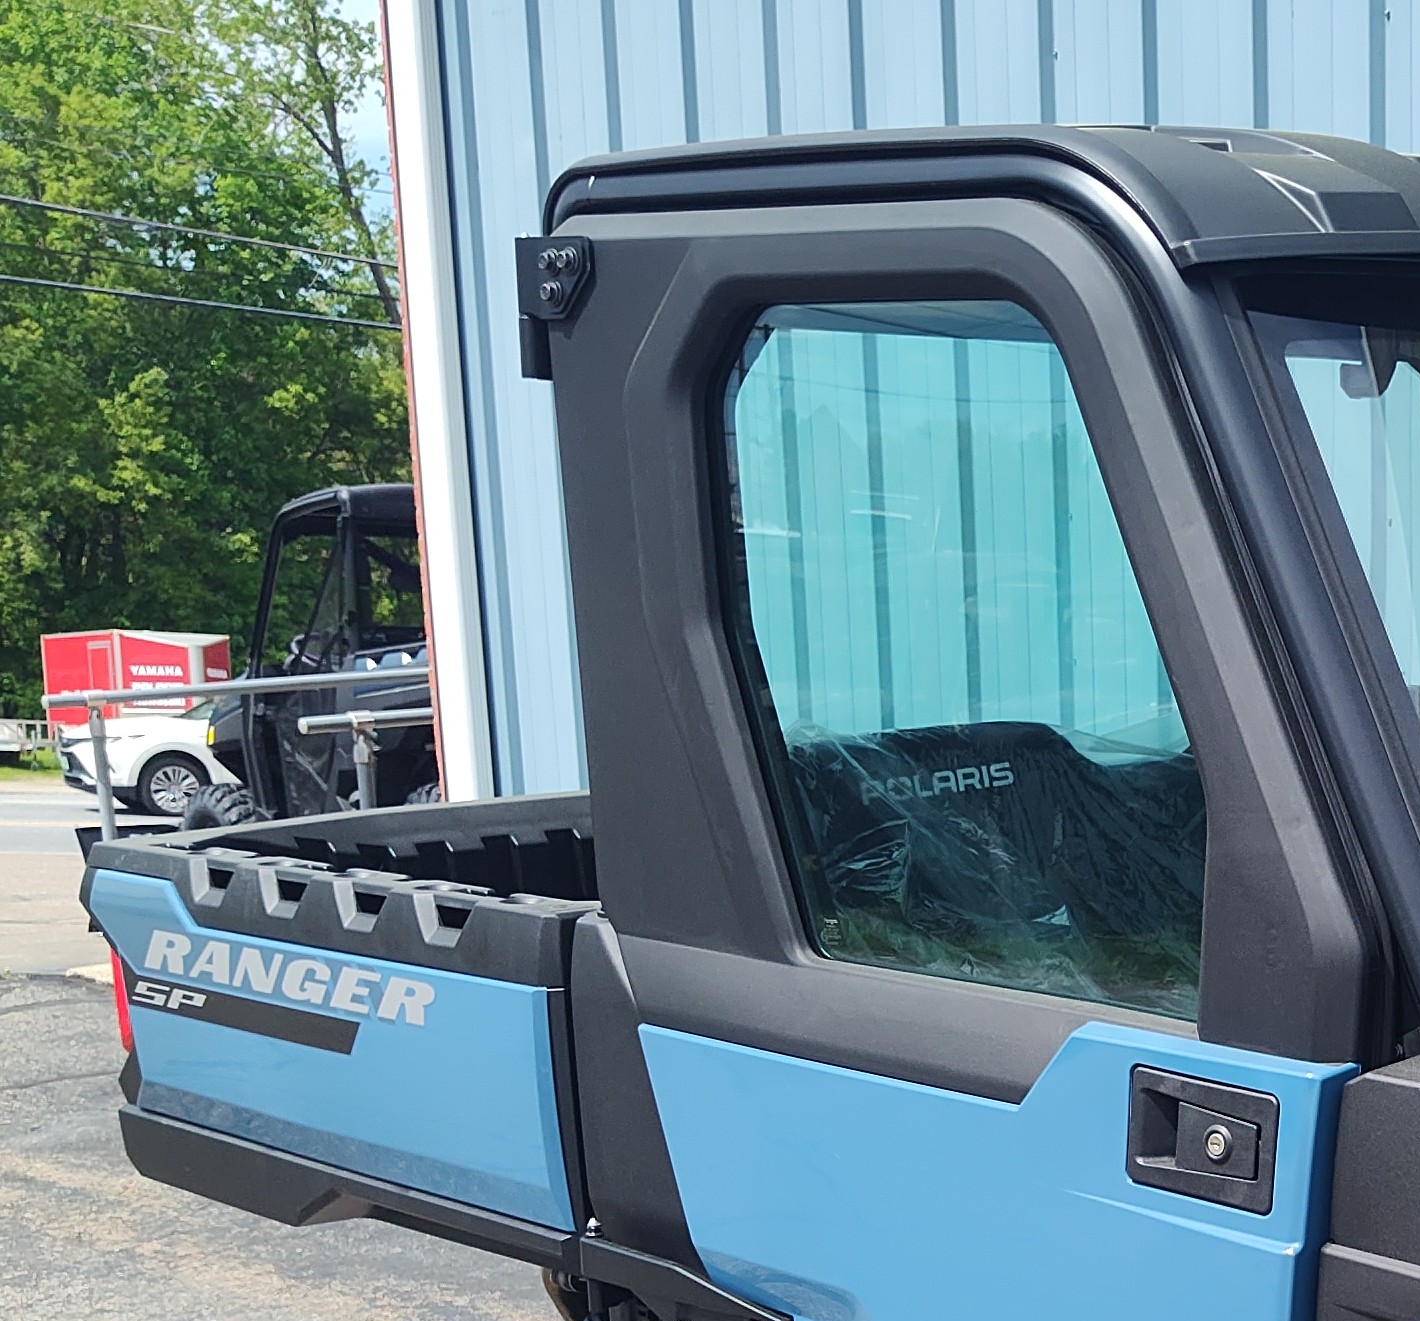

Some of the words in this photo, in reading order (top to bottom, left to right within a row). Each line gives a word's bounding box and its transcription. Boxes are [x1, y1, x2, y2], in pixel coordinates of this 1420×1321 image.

[129, 665, 183, 677] YAMAHA
[861, 762, 1015, 805] POLARIS
[132, 980, 207, 1010] SP
[144, 930, 436, 1026] RANGER
